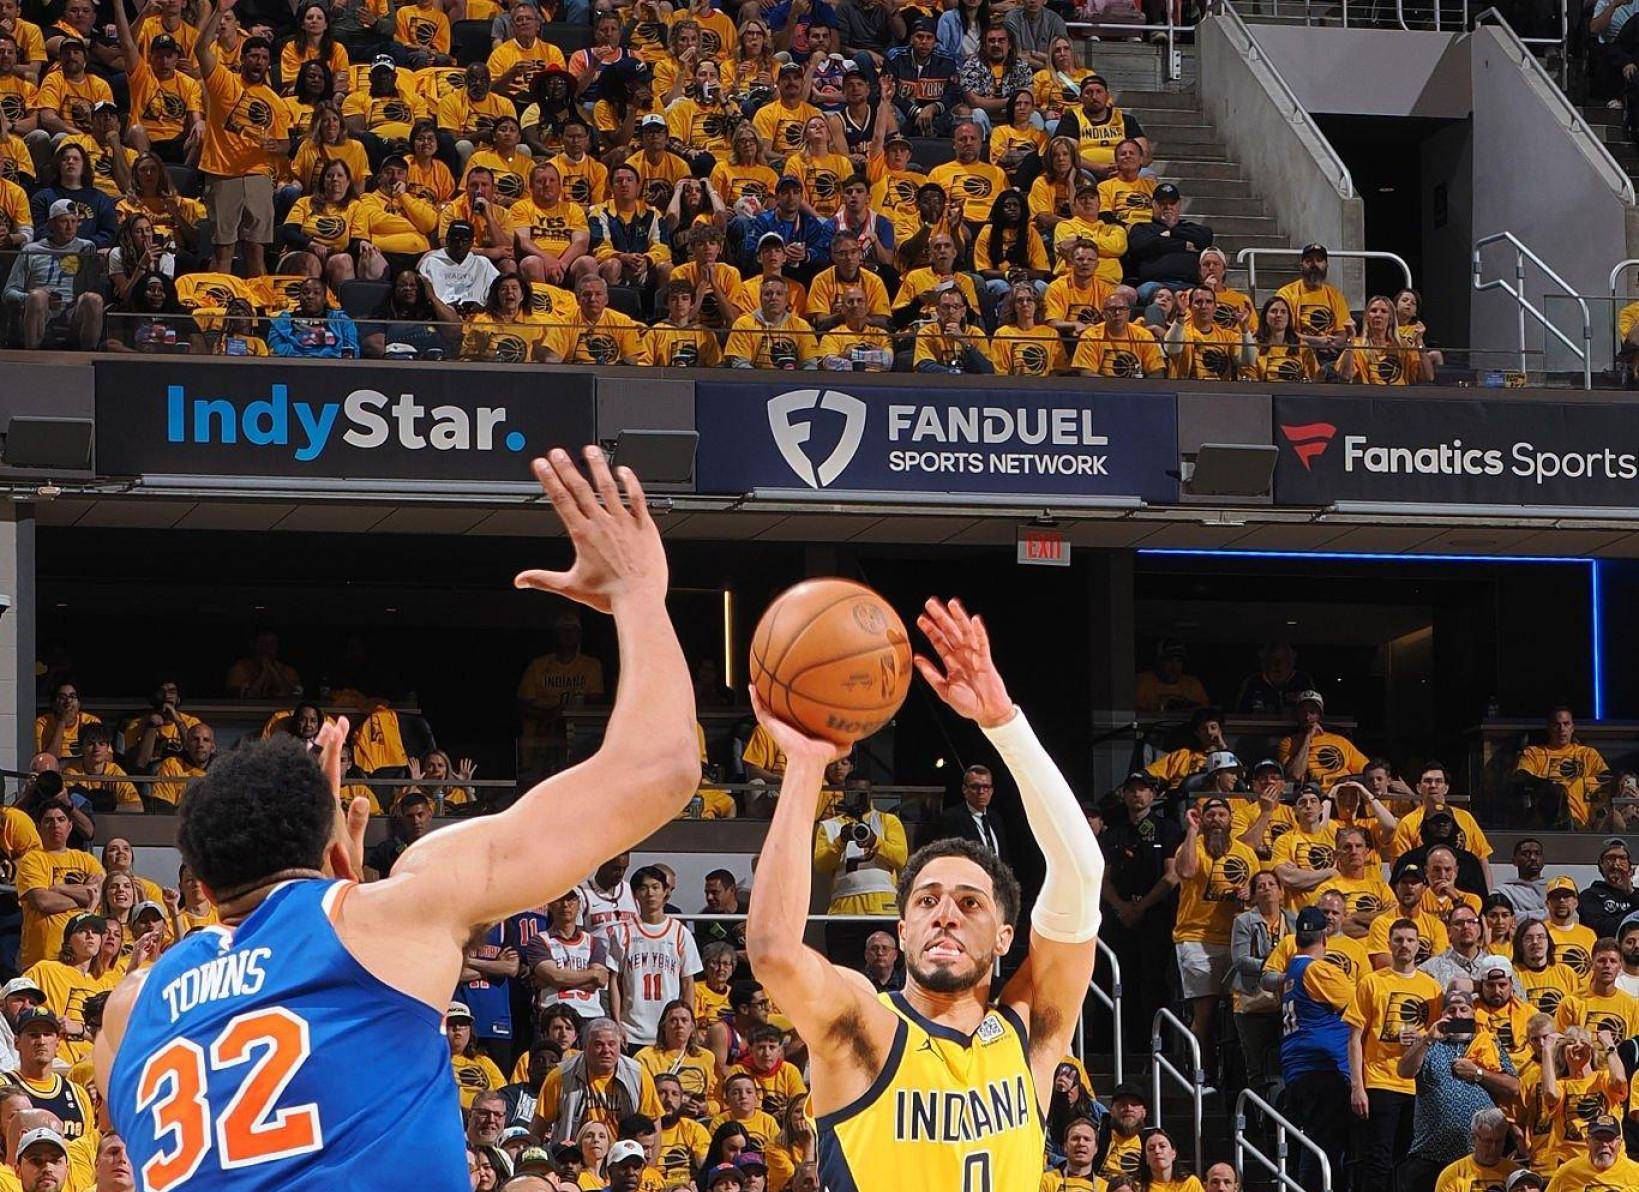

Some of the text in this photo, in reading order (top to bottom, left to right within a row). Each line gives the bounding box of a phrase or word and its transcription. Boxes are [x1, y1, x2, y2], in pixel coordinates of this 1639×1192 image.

[535, 215, 566, 228] YES
[168, 384, 526, 462] IndyStar.
[889, 404, 1109, 446] FANDUEL
[889, 450, 1109, 477] SPORTS NETWORK
[1344, 435, 1637, 485] Fanatics Sports
[1026, 532, 1062, 560] EXIT
[626, 951, 678, 976] NEW YORK
[162, 947, 271, 1024] TOWNS
[643, 973, 662, 1001] 11
[894, 1075, 1030, 1142] INDIANA
